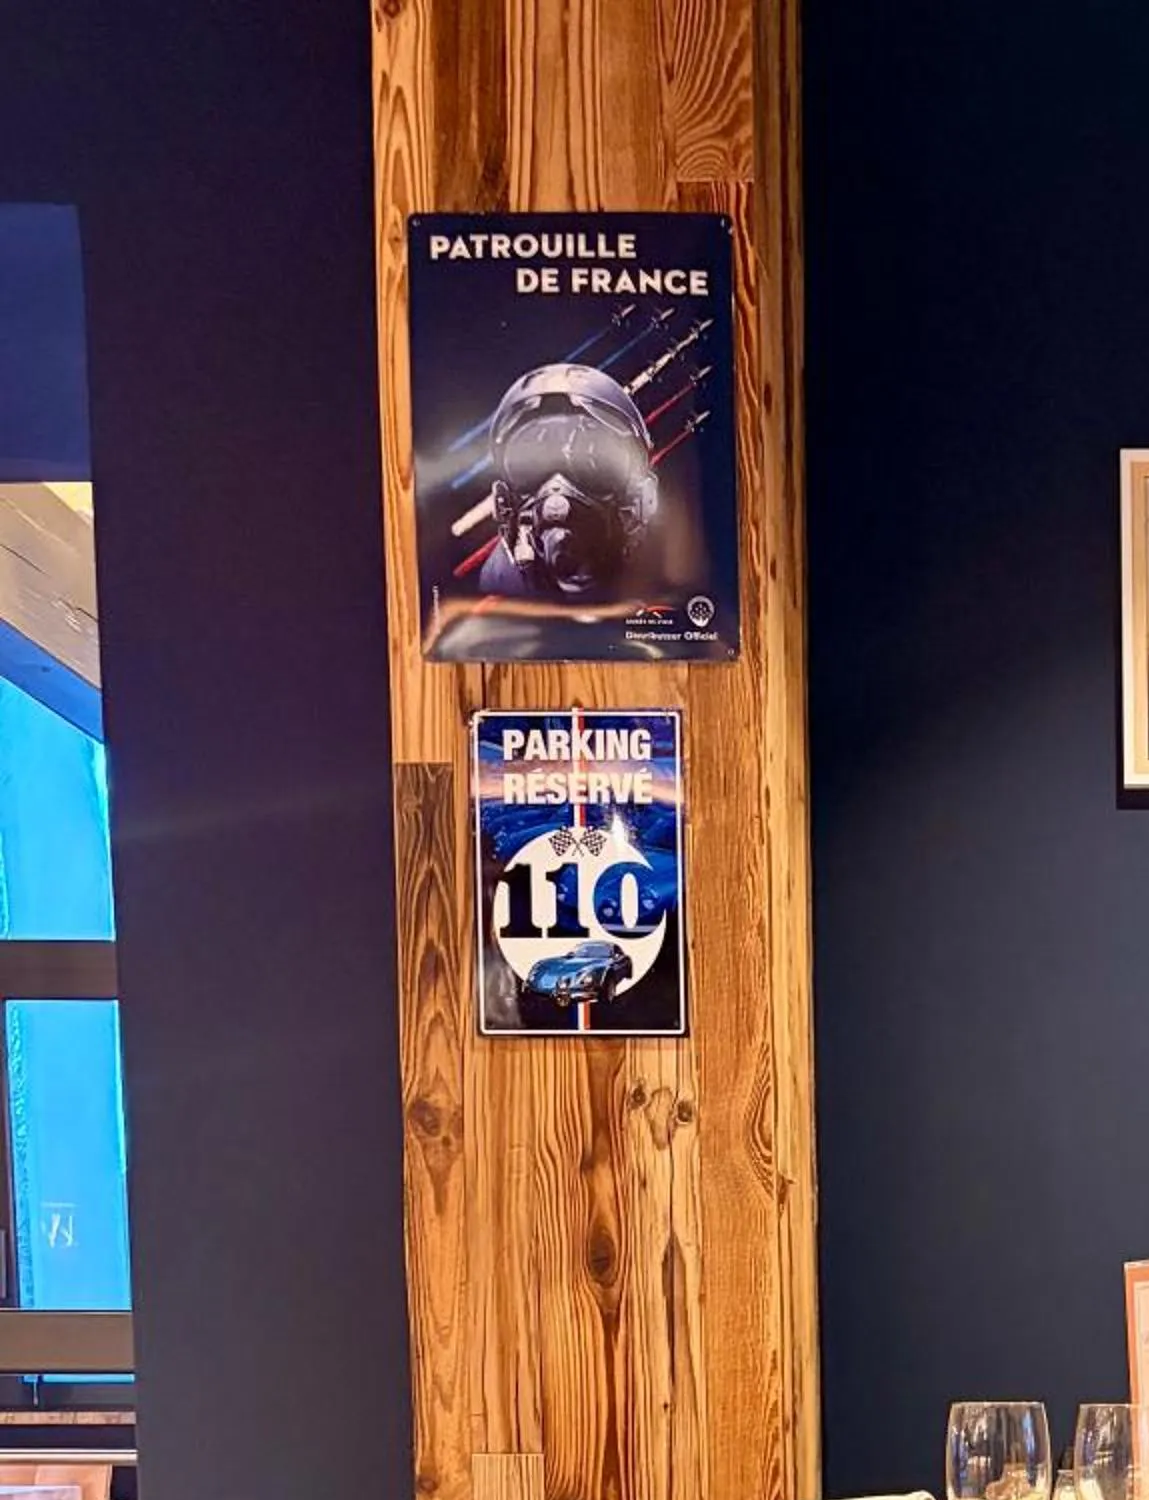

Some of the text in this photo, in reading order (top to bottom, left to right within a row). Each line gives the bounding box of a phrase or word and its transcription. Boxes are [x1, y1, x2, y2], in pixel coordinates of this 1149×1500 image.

[430, 233, 637, 260] PATROUILLE
[516, 268, 709, 296] DE FRANCE
[502, 729, 652, 761] PARKING
[503, 768, 653, 804] RÉSERVÉ
[500, 862, 666, 939] 110
